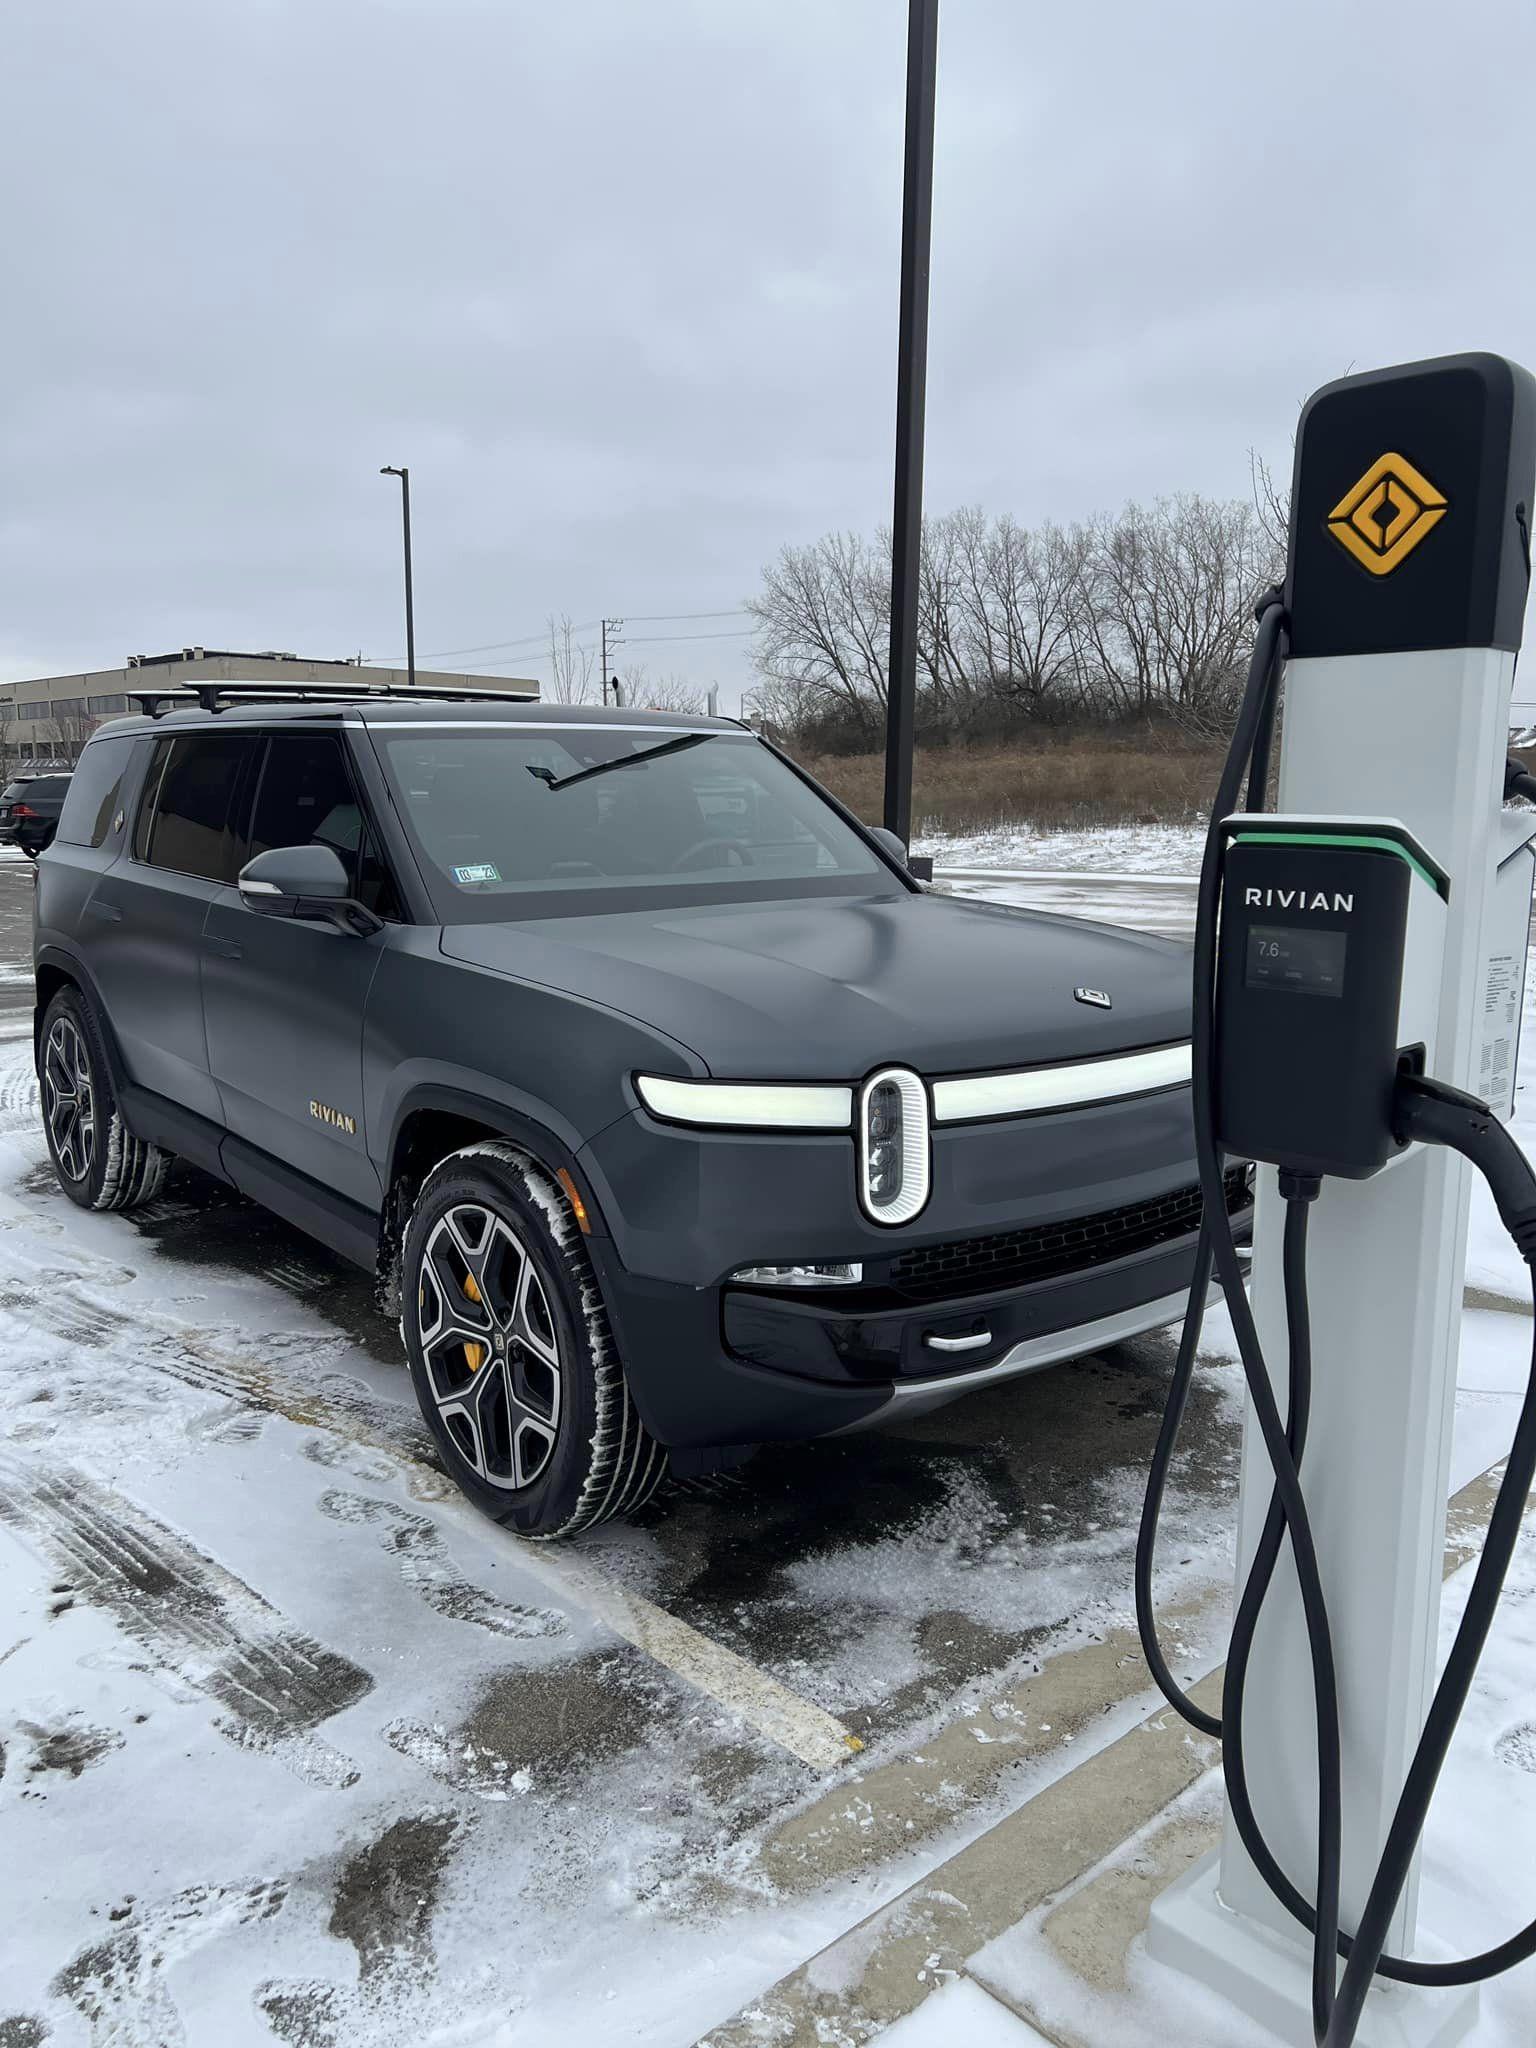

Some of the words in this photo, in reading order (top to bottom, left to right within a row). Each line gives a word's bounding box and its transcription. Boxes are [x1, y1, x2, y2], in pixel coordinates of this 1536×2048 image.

[1245, 887, 1354, 912] RIVIAN
[1258, 941, 1280, 957] 7.6
[309, 1100, 356, 1134] RIVIAN
